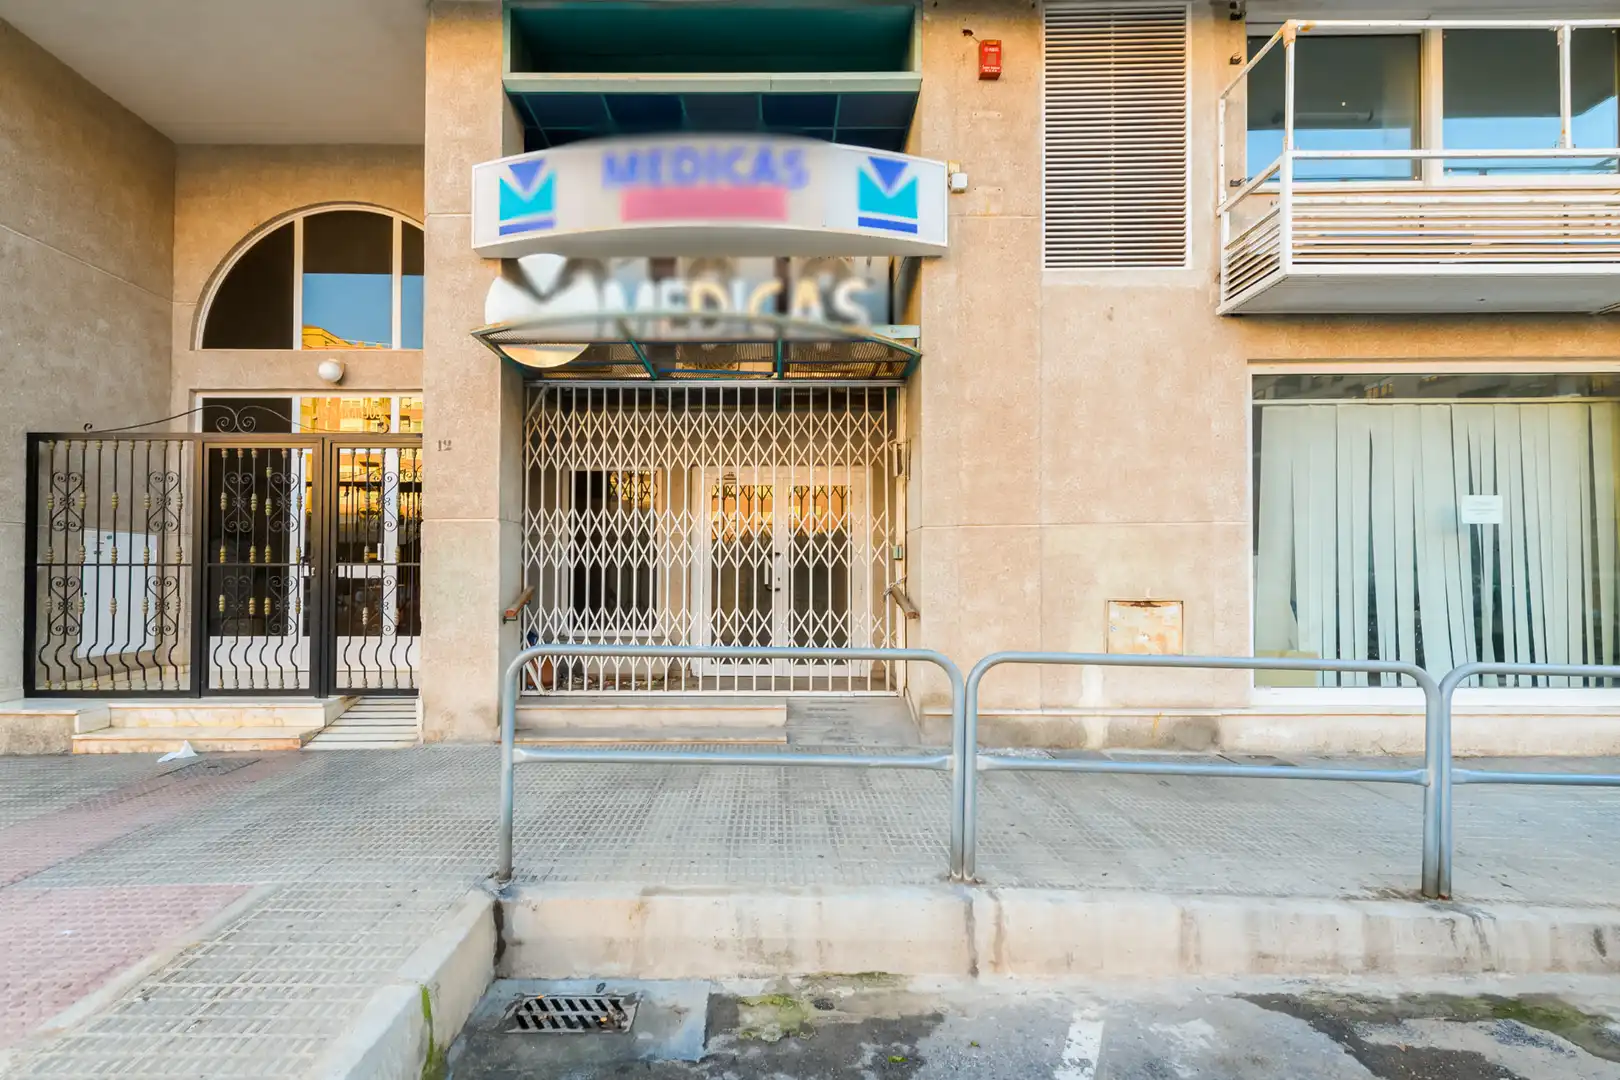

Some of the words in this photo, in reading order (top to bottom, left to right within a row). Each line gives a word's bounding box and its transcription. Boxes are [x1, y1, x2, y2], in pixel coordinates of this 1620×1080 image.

[601, 144, 809, 190] MEDICAS
[600, 276, 871, 328] MEDICAS
[437, 439, 452, 451] 12
